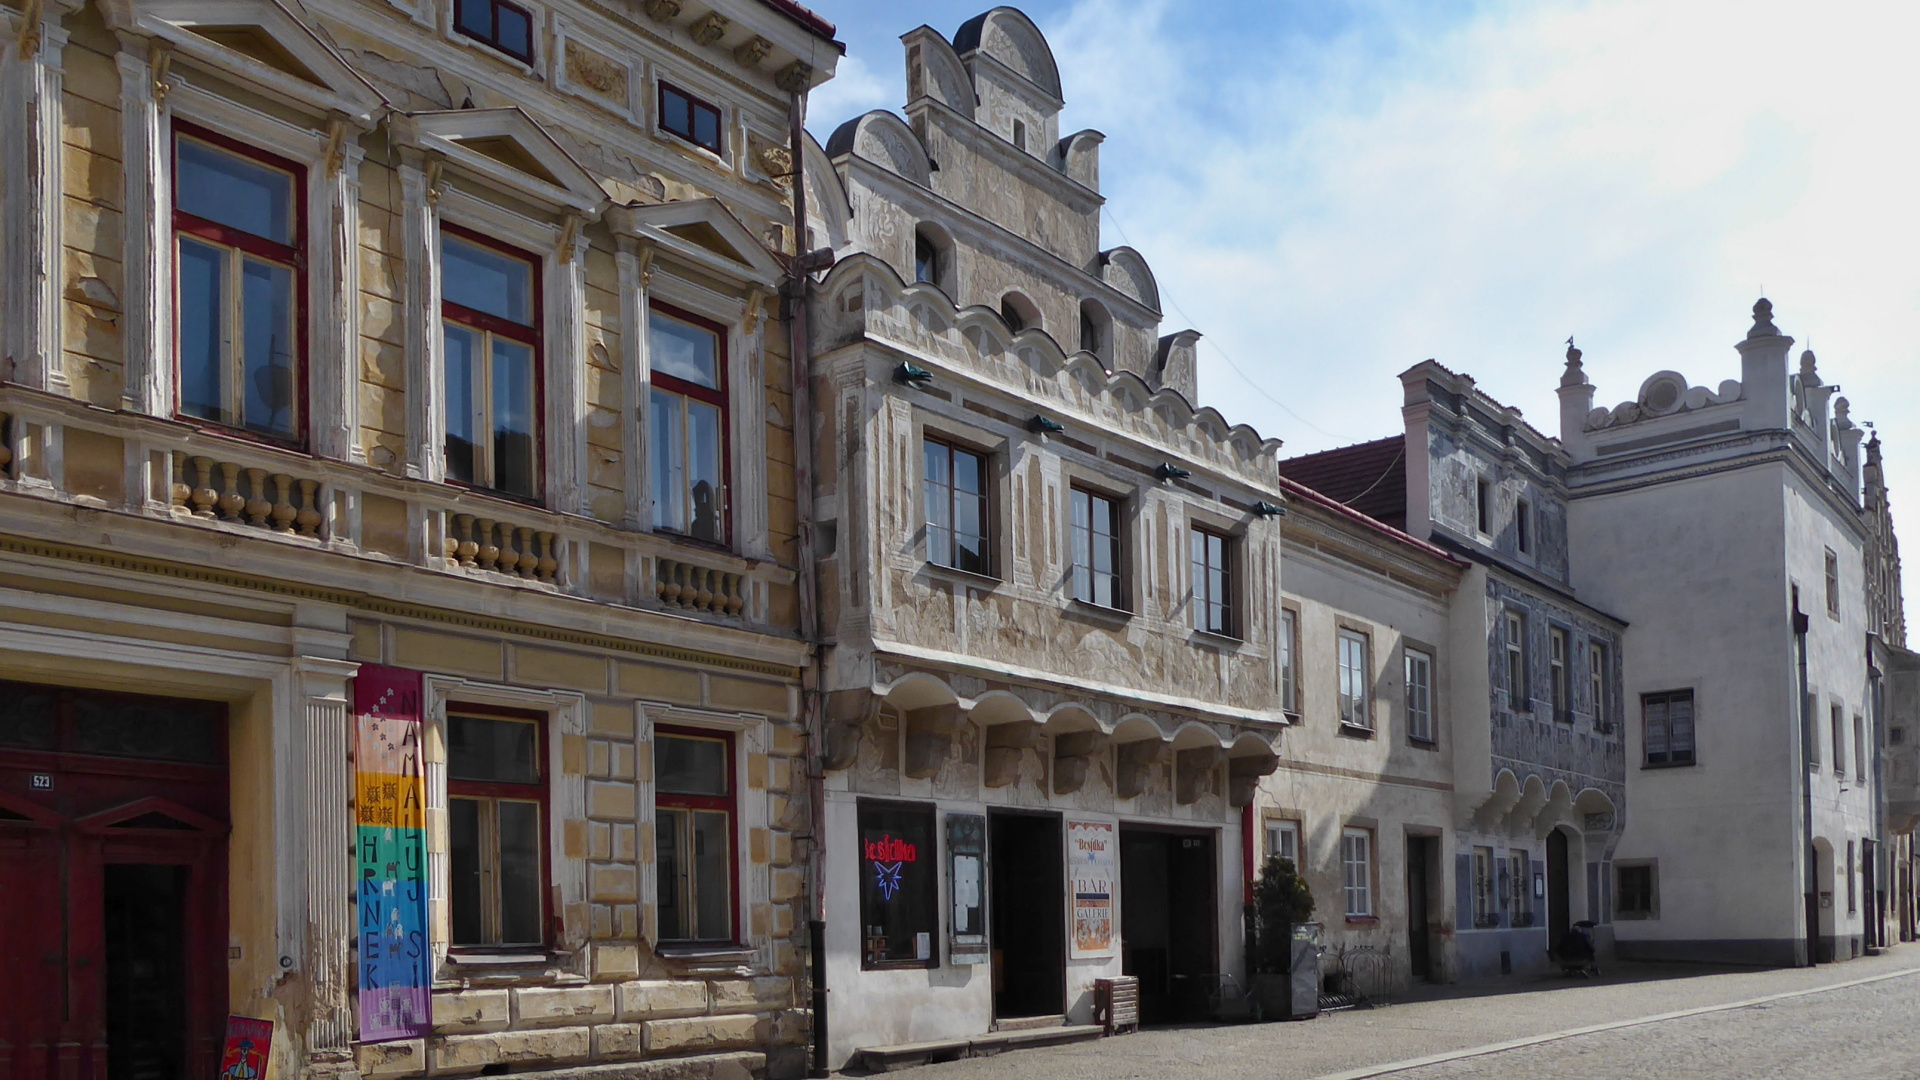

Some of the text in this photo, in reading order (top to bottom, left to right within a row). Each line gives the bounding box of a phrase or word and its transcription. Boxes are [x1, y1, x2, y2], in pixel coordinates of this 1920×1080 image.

[34, 775, 49, 787] 523
[401, 690, 421, 902] NAMALUJ
[1078, 879, 1107, 893] BAR
[362, 835, 381, 991] HRNEK
[1077, 908, 1109, 918] GALERIE
